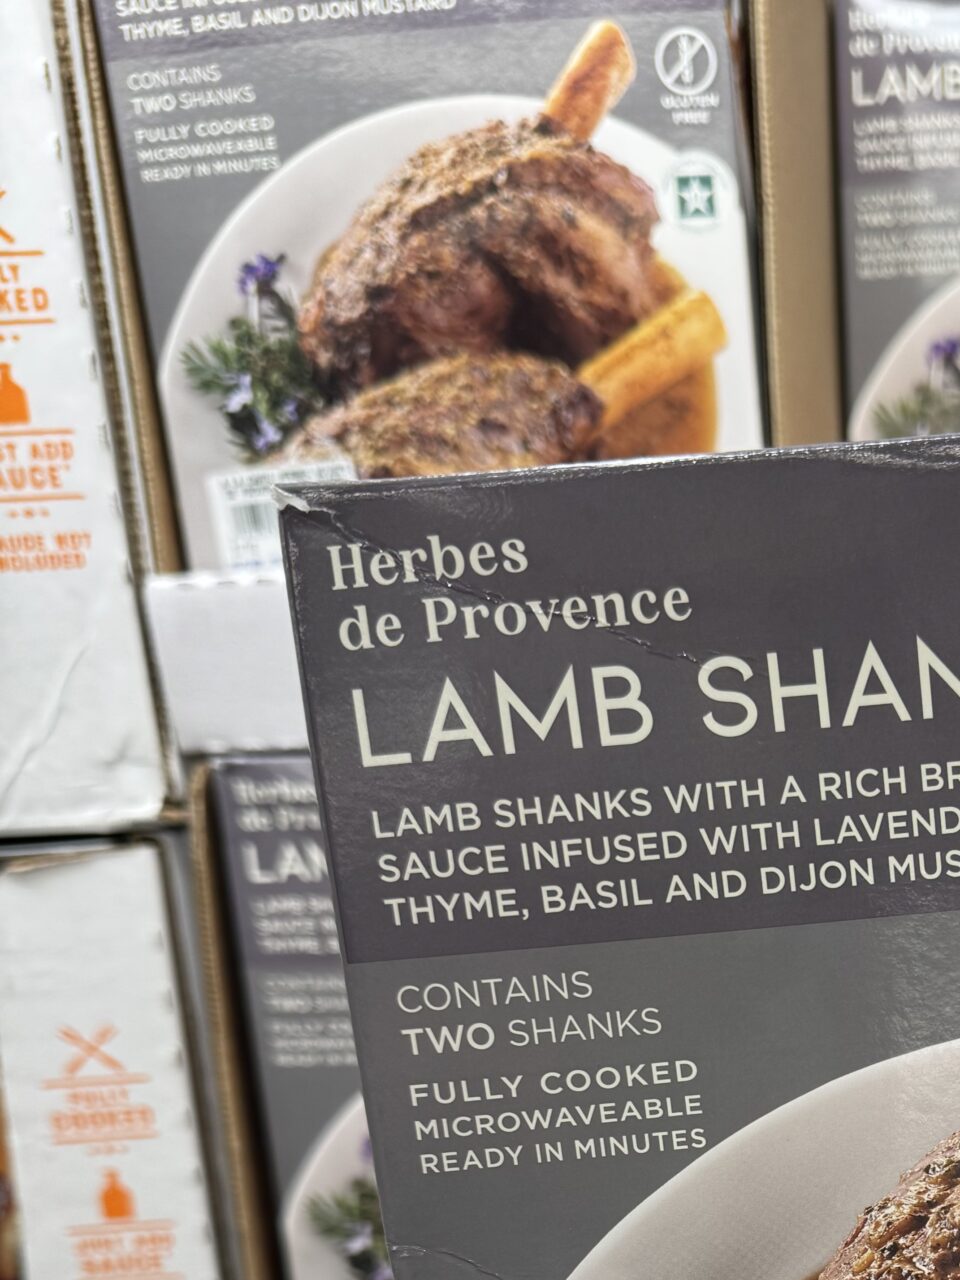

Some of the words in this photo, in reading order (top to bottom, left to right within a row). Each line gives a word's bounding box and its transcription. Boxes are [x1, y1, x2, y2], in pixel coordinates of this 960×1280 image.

[190, 11, 248, 33] BASIL
[251, 6, 294, 27] AND
[298, 1, 358, 22] DIJON
[127, 64, 222, 91] CONTAINS
[131, 96, 177, 115] TWO
[180, 85, 256, 109] SHANKS
[135, 124, 190, 144] FULLY
[194, 114, 275, 138] COOKED
[327, 534, 529, 591] Herbes
[338, 604, 405, 651] de
[421, 585, 692, 643] Provence
[352, 663, 654, 768] LAMB
[371, 802, 482, 839] LAMB
[493, 787, 653, 829] SHANKS
[663, 778, 767, 814] WITH
[780, 775, 807, 805] A
[818, 765, 907, 801] RICH
[378, 844, 510, 883] SAUCE
[520, 830, 688, 872] INFUSED
[699, 820, 800, 856] WITH
[383, 888, 530, 927] THYME,
[541, 878, 653, 915] BASIL
[665, 869, 747, 904] AND
[761, 857, 875, 895] DIJON
[397, 970, 593, 1013] CONTAINS
[401, 1022, 495, 1056] TWO
[508, 1007, 663, 1047] SHANKS
[409, 1074, 524, 1107] FULLY
[540, 1059, 698, 1095] COOKED
[414, 1094, 703, 1141] MICROWAVEABLE
[420, 1144, 524, 1175] READY
[535, 1141, 564, 1164] IN
[574, 1127, 707, 1160] MINUTES
